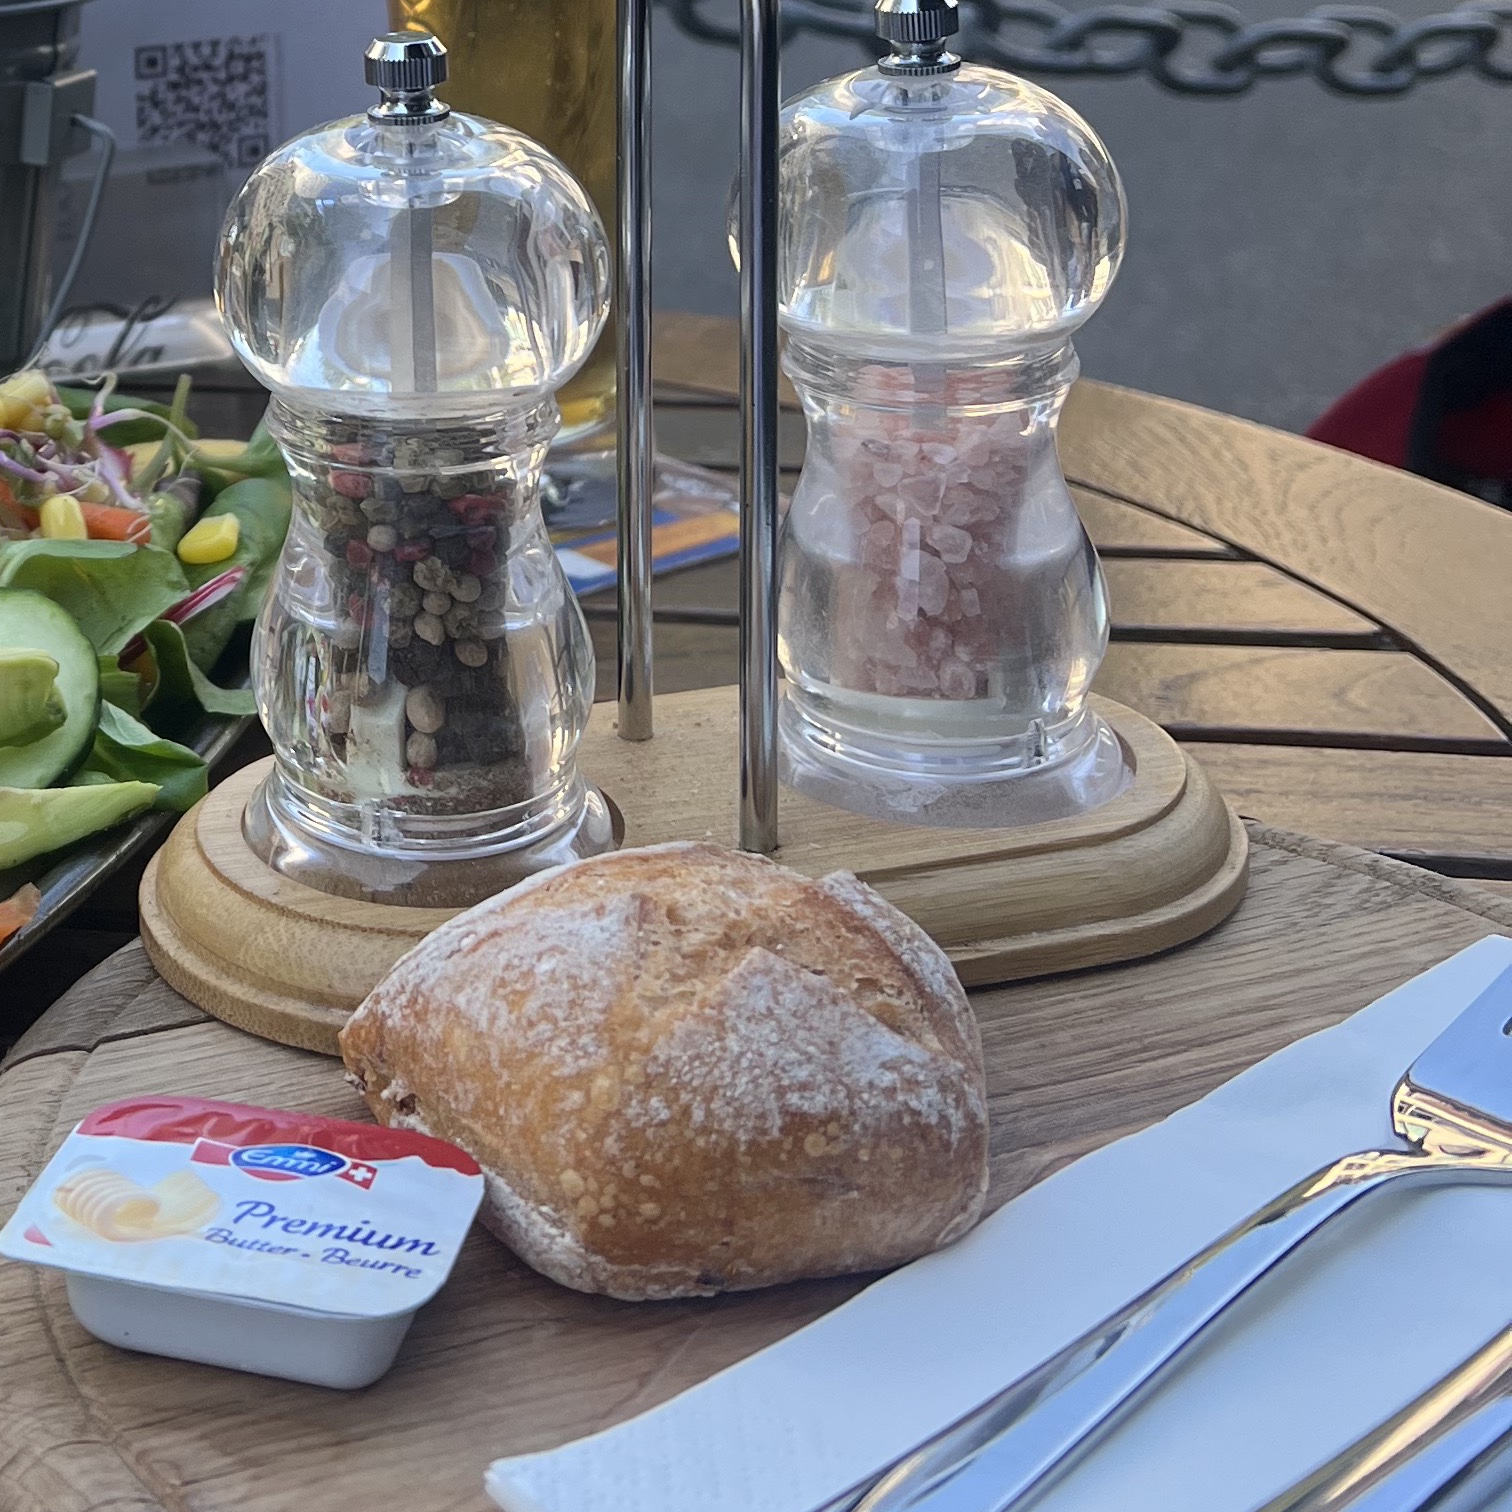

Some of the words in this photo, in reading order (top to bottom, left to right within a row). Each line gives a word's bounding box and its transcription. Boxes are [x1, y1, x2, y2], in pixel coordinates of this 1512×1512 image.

[240, 1148, 336, 1174] Emmi
[204, 1227, 297, 1257] Butter
[321, 1247, 423, 1280] Beurre
[233, 1199, 441, 1257] Premium
